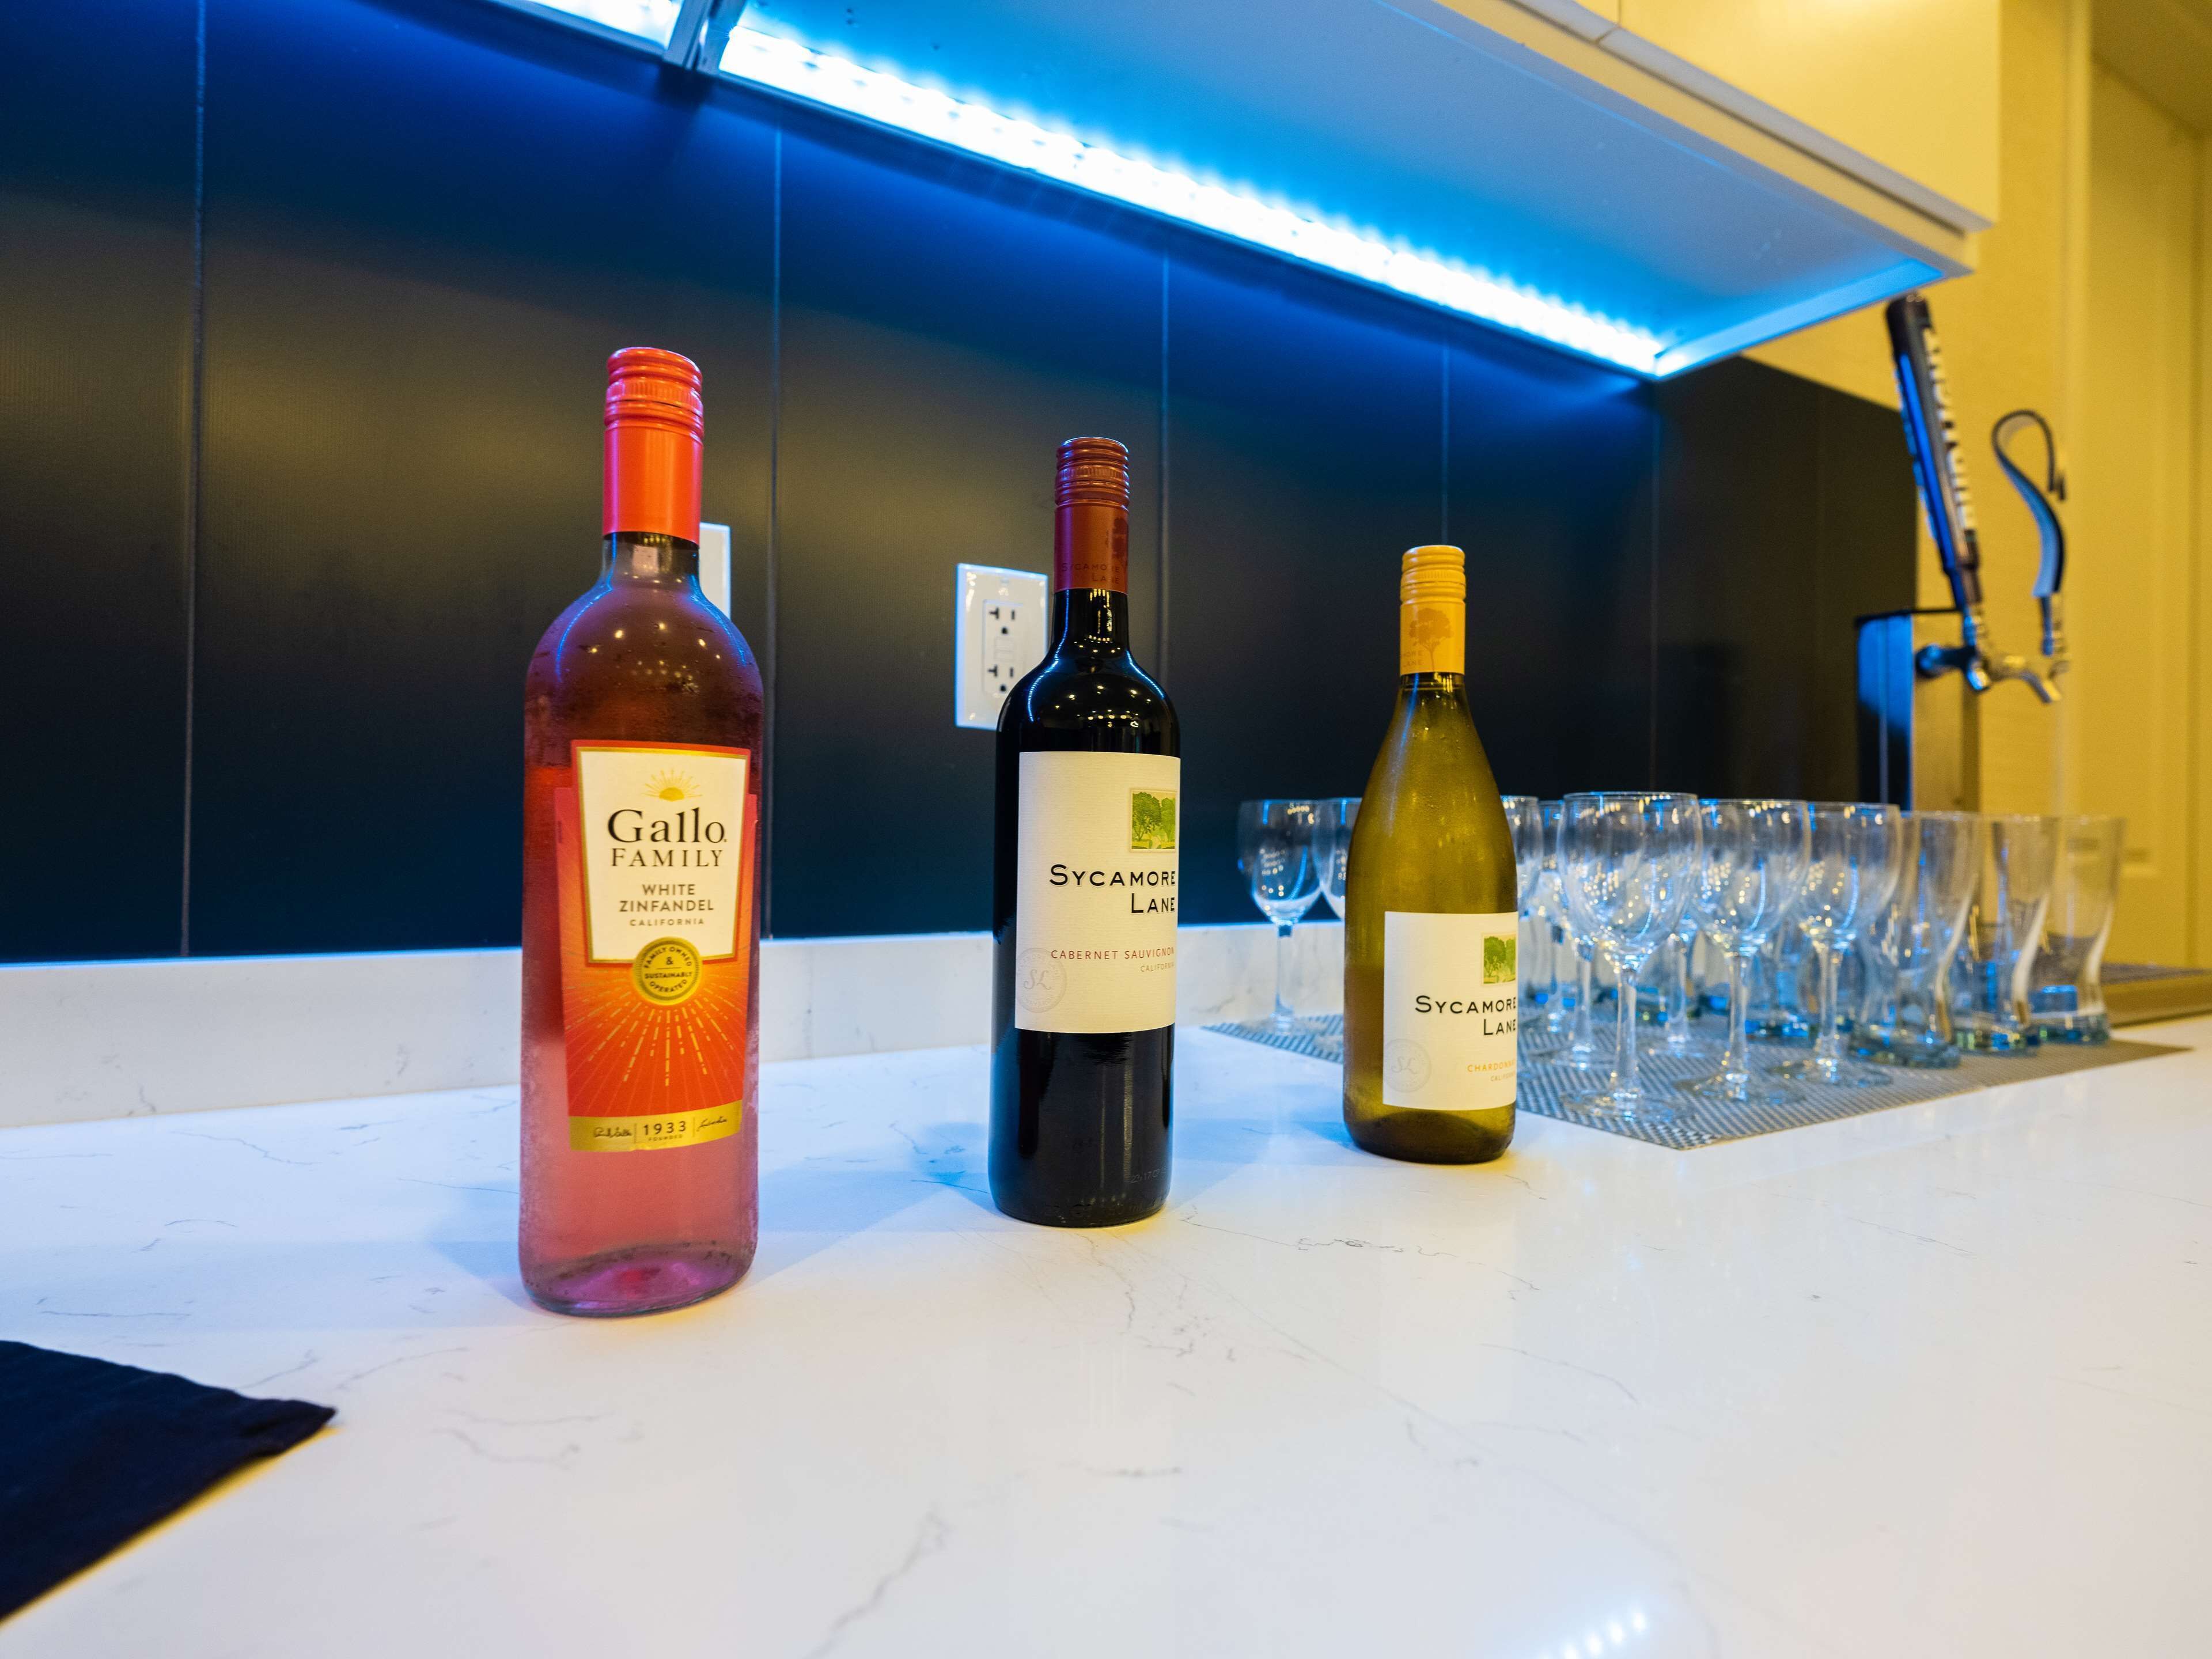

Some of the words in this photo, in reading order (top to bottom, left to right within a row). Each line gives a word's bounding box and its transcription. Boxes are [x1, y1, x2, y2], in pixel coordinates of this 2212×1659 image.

[611, 848, 723, 867] FAMILY
[1049, 864, 1176, 886] SYCAMORE
[642, 884, 696, 895] WHITE
[619, 900, 714, 912] ZINFANDEL
[1131, 893, 1175, 914] LANE
[630, 918, 704, 927] CALIFORNIA
[643, 947, 666, 968] FAMILY
[669, 946, 692, 966] OWNED
[1051, 950, 1118, 960] CABERNET
[1124, 946, 1175, 959] SAUVIGNON
[666, 957, 673, 965] &
[649, 979, 687, 992] OPERATED
[1415, 995, 1516, 1014] SYCAMORE
[1483, 1018, 1516, 1036] LANE
[643, 1121, 686, 1135] 1933
